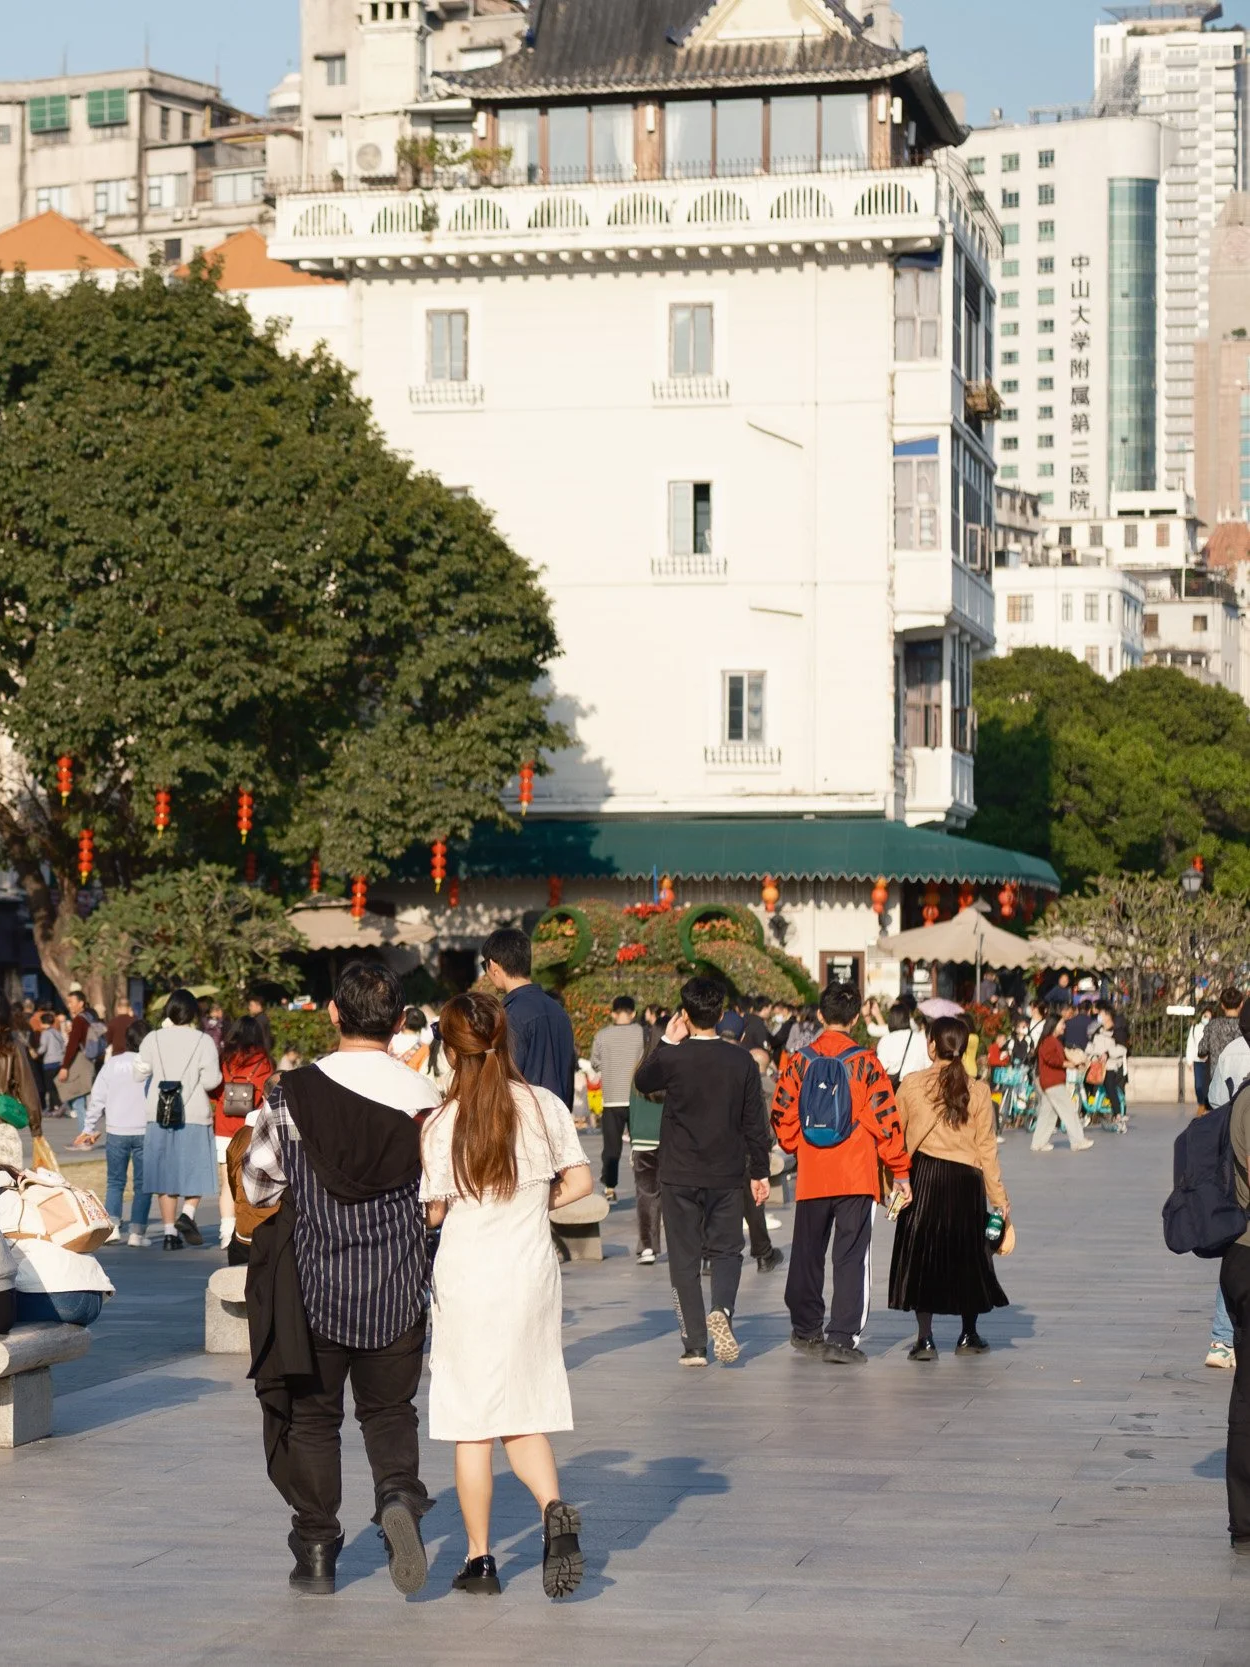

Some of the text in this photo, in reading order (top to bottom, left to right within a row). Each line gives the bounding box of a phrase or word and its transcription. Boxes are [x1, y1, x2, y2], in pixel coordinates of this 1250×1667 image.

[1070, 254, 1090, 512] 中山大学附属第二医院
